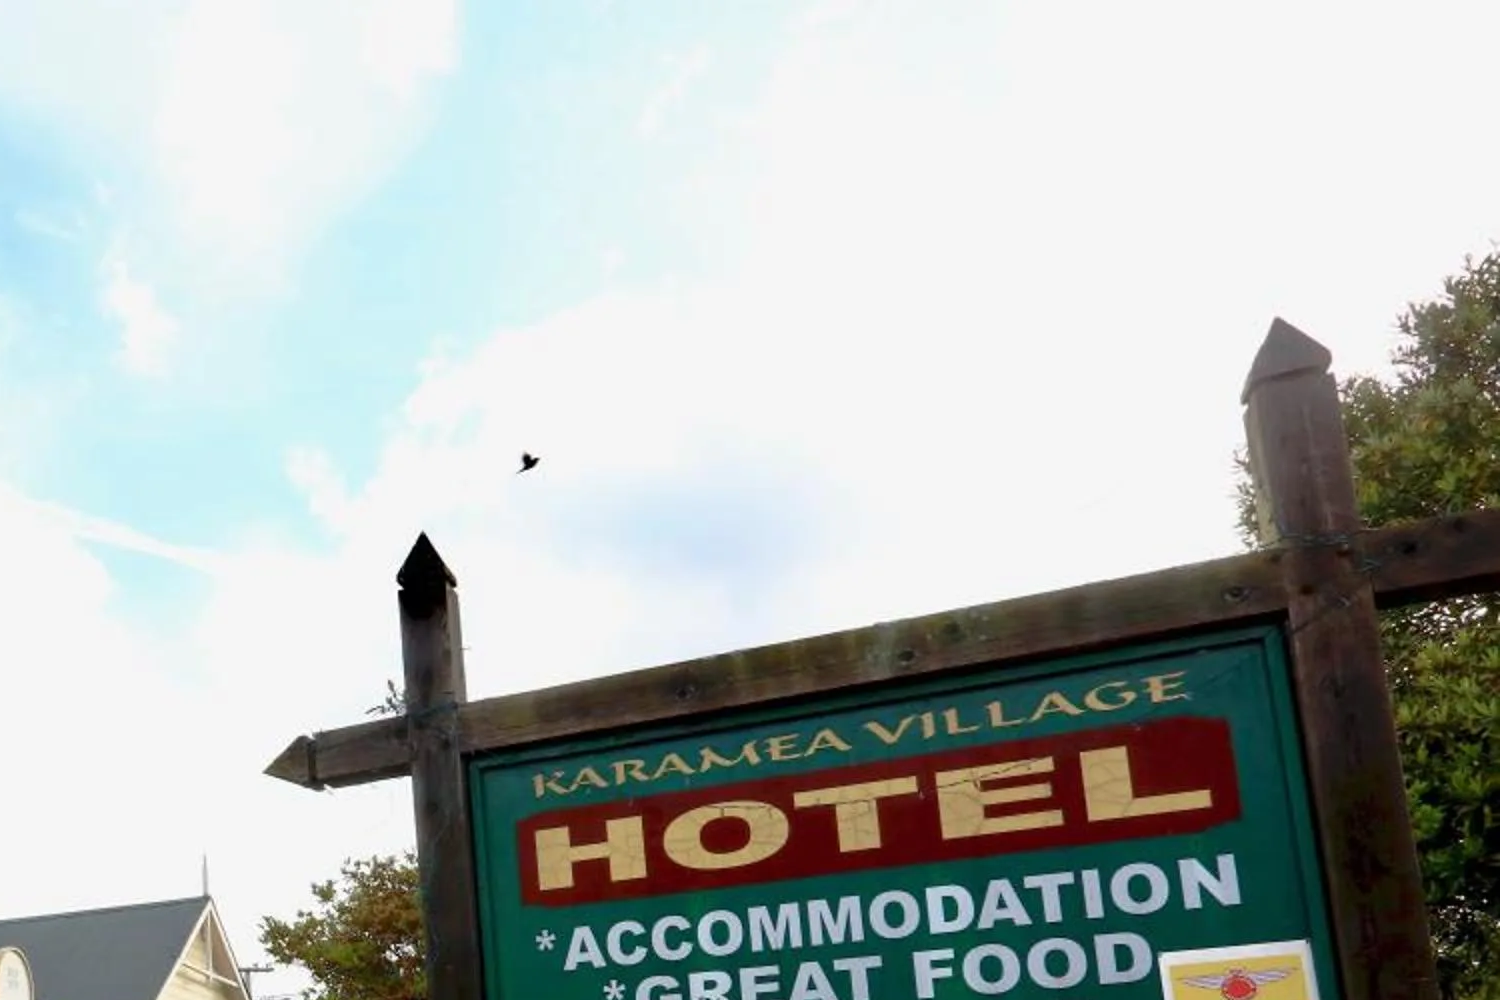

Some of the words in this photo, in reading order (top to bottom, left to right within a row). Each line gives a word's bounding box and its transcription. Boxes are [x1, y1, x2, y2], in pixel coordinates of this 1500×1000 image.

[532, 728, 852, 799] KARAMEA
[863, 670, 1191, 745] VILLAGE
[535, 745, 1213, 891] HOTEL
[913, 931, 1152, 1000] FOOD
